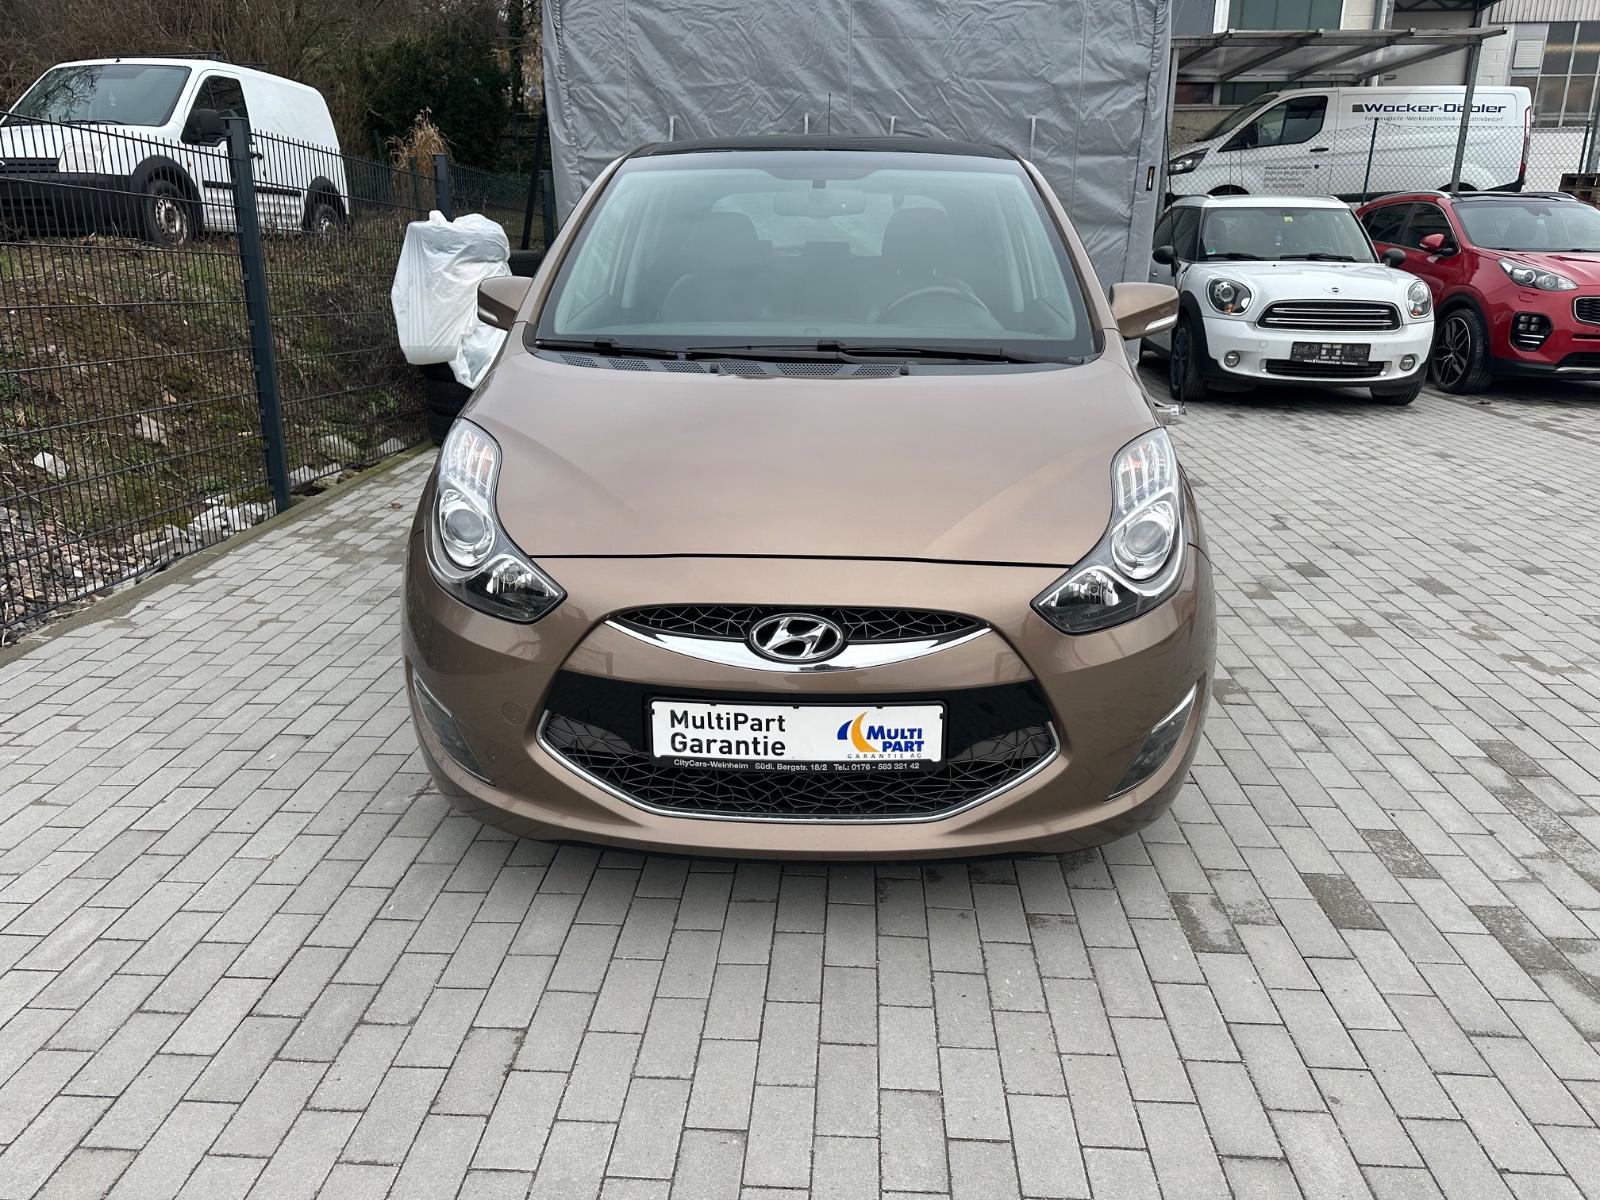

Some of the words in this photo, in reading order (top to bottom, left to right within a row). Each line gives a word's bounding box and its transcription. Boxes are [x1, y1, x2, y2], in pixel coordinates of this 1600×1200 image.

[670, 709, 785, 732] MultiPart
[866, 725, 922, 739] MULTI
[670, 732, 785, 756] Garantie
[883, 740, 924, 752] PART
[673, 759, 748, 769] CityCars-Weinheim
[755, 762, 775, 770] Südl.
[777, 763, 808, 772] Bergstr.
[834, 763, 850, 771] Tel.:
[851, 763, 871, 771] 0176
